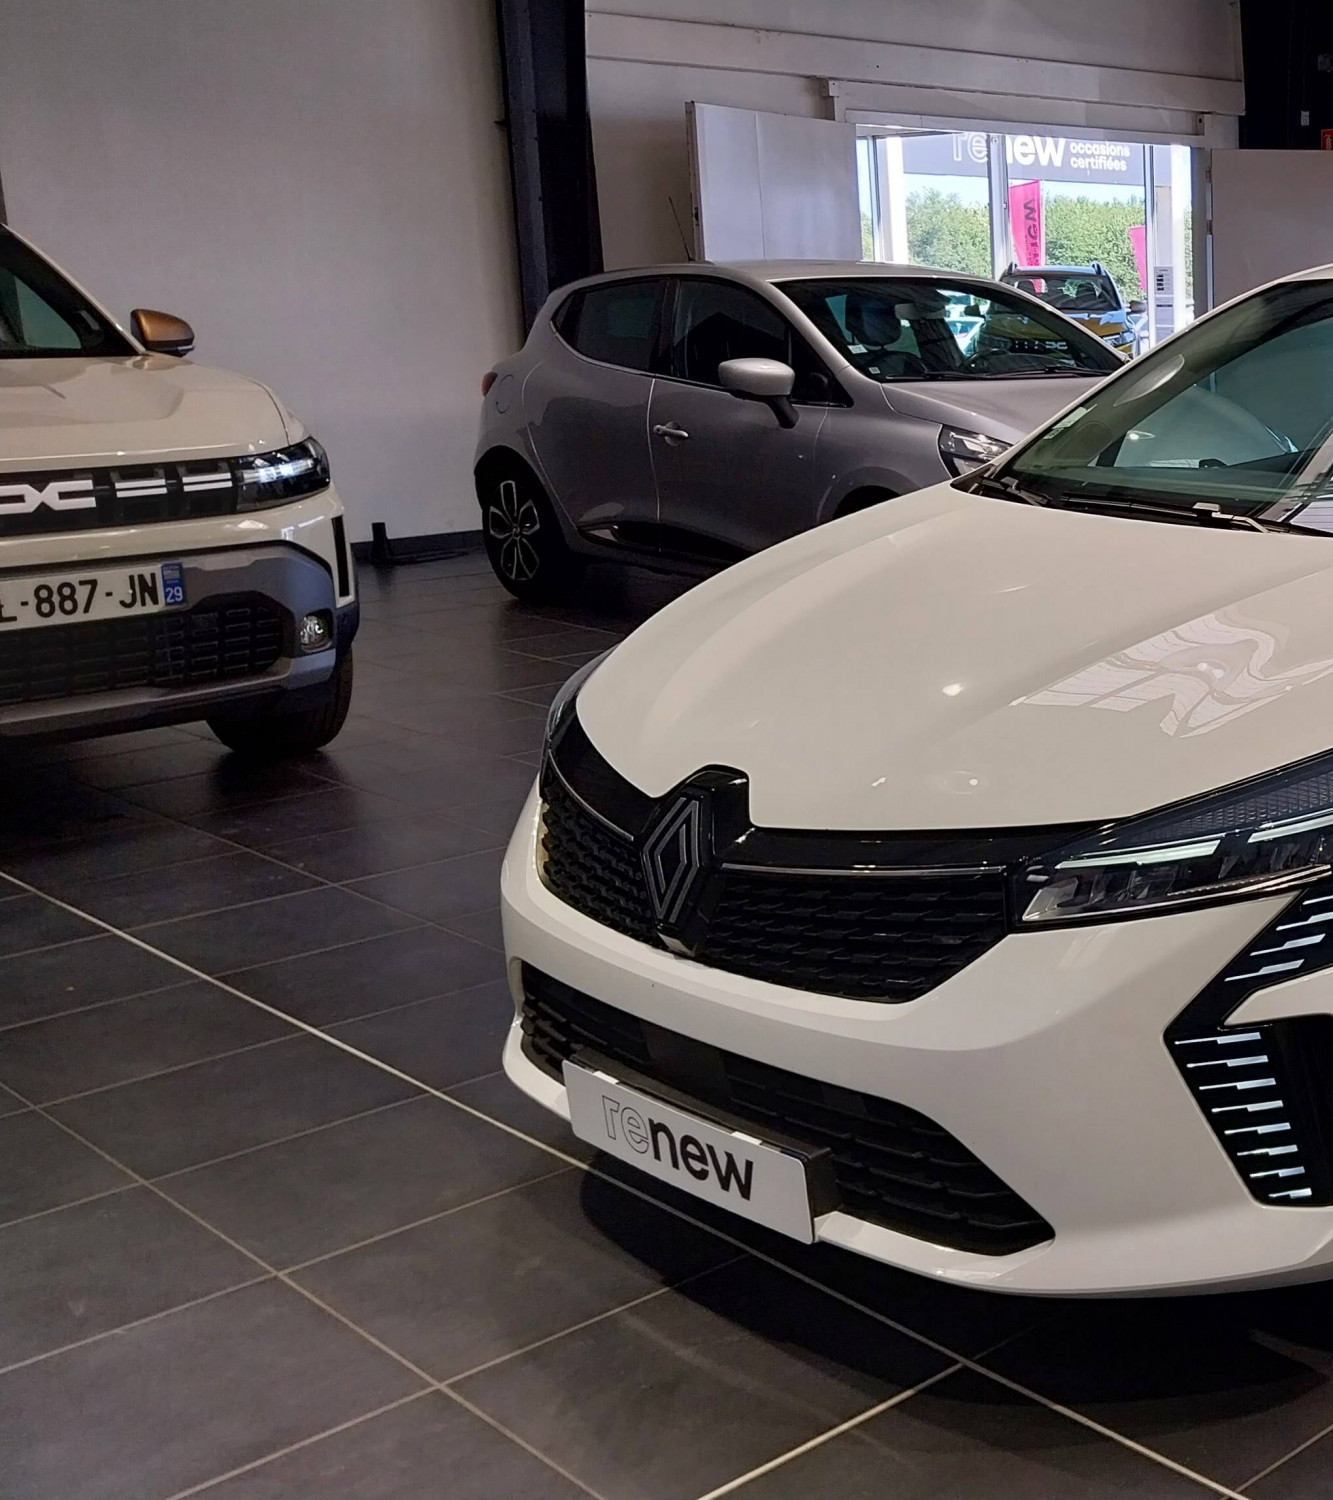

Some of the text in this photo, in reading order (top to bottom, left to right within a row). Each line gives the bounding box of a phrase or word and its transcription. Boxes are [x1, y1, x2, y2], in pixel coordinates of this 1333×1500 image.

[952, 132, 1066, 168] reew
[1069, 141, 1131, 158] occasions
[1069, 155, 1128, 172] certifiées
[165, 586, 183, 603] 29
[601, 1094, 754, 1202] renew
